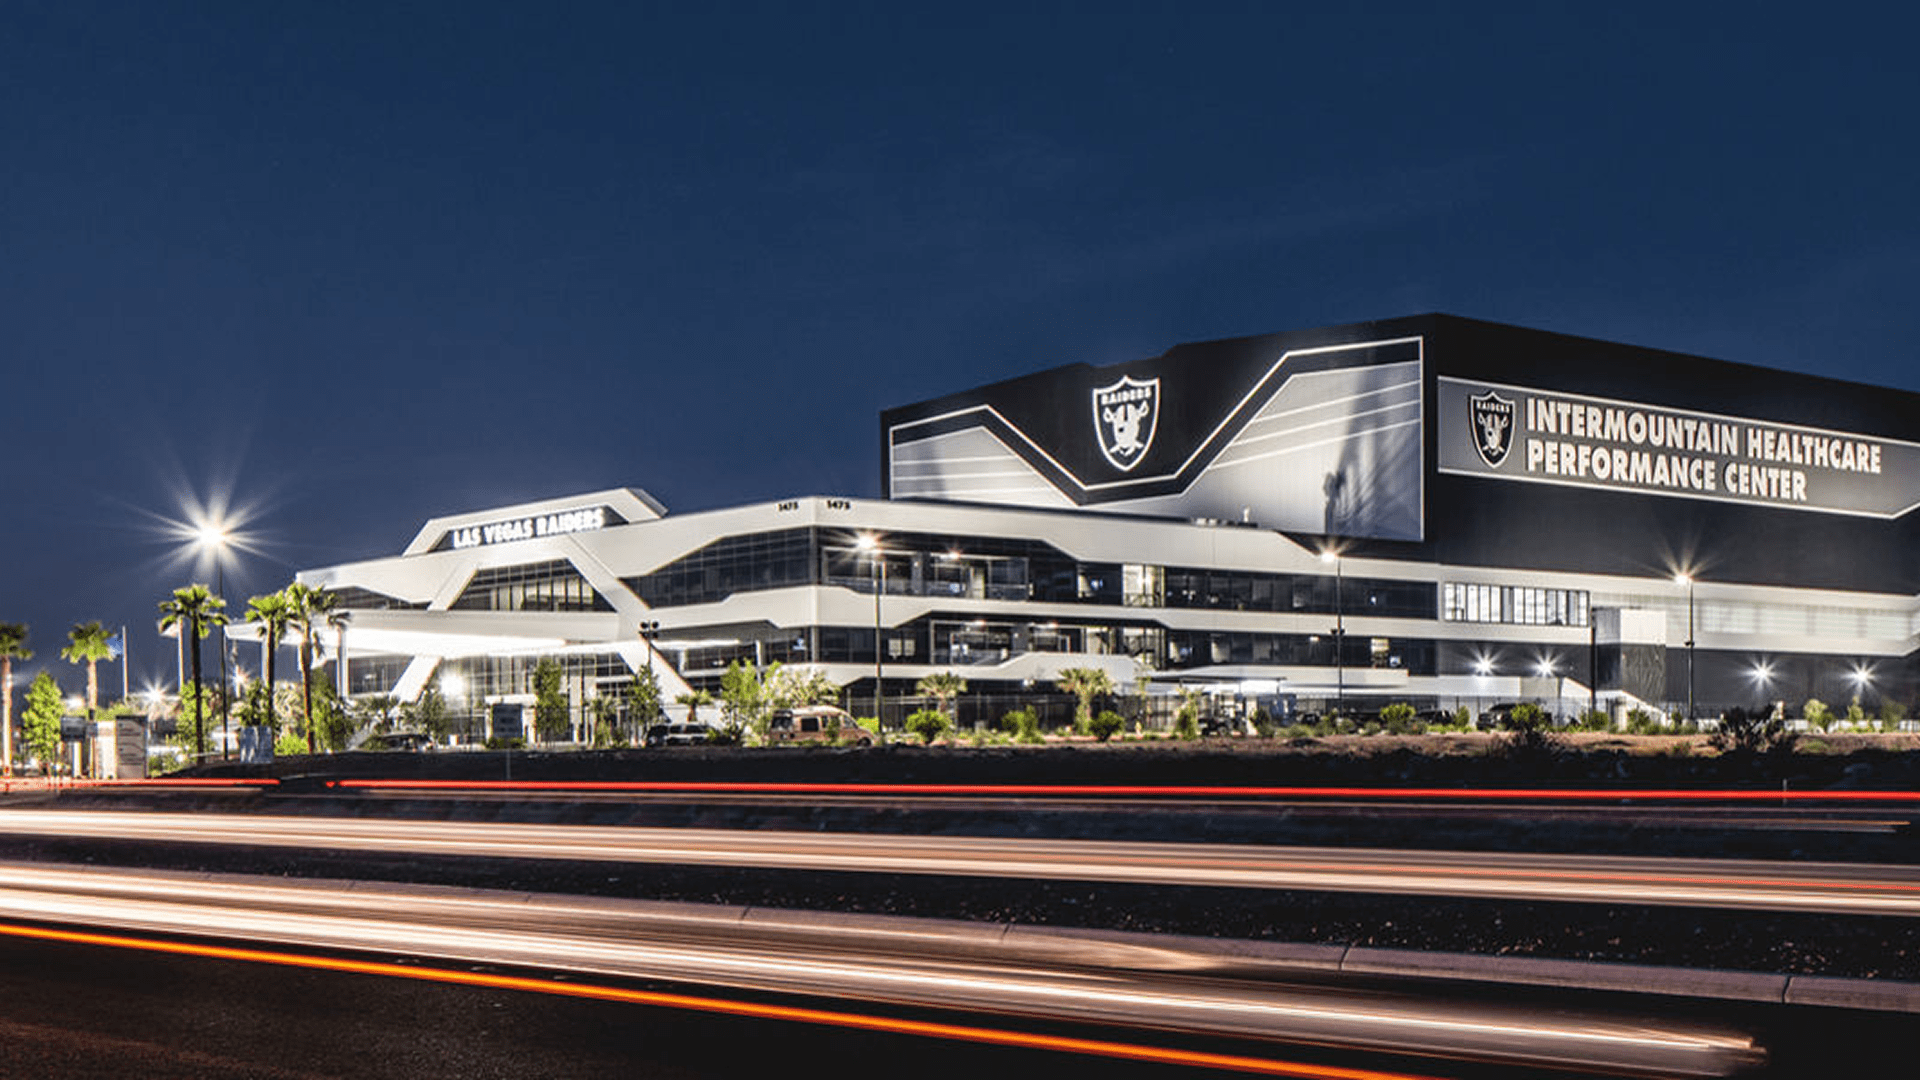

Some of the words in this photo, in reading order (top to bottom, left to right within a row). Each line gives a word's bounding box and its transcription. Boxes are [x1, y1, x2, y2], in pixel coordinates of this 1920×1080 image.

[1101, 386, 1152, 405] RAIDERS
[1527, 397, 1739, 457] INTERMOUNTAIN
[1747, 427, 1882, 475] HEALTHCARE
[1527, 438, 1717, 491] PERFORMANCE
[1724, 462, 1808, 501] CENTER
[453, 528, 482, 549] LAS
[484, 518, 535, 545] VEGAS
[536, 508, 605, 538] RAIDERS
